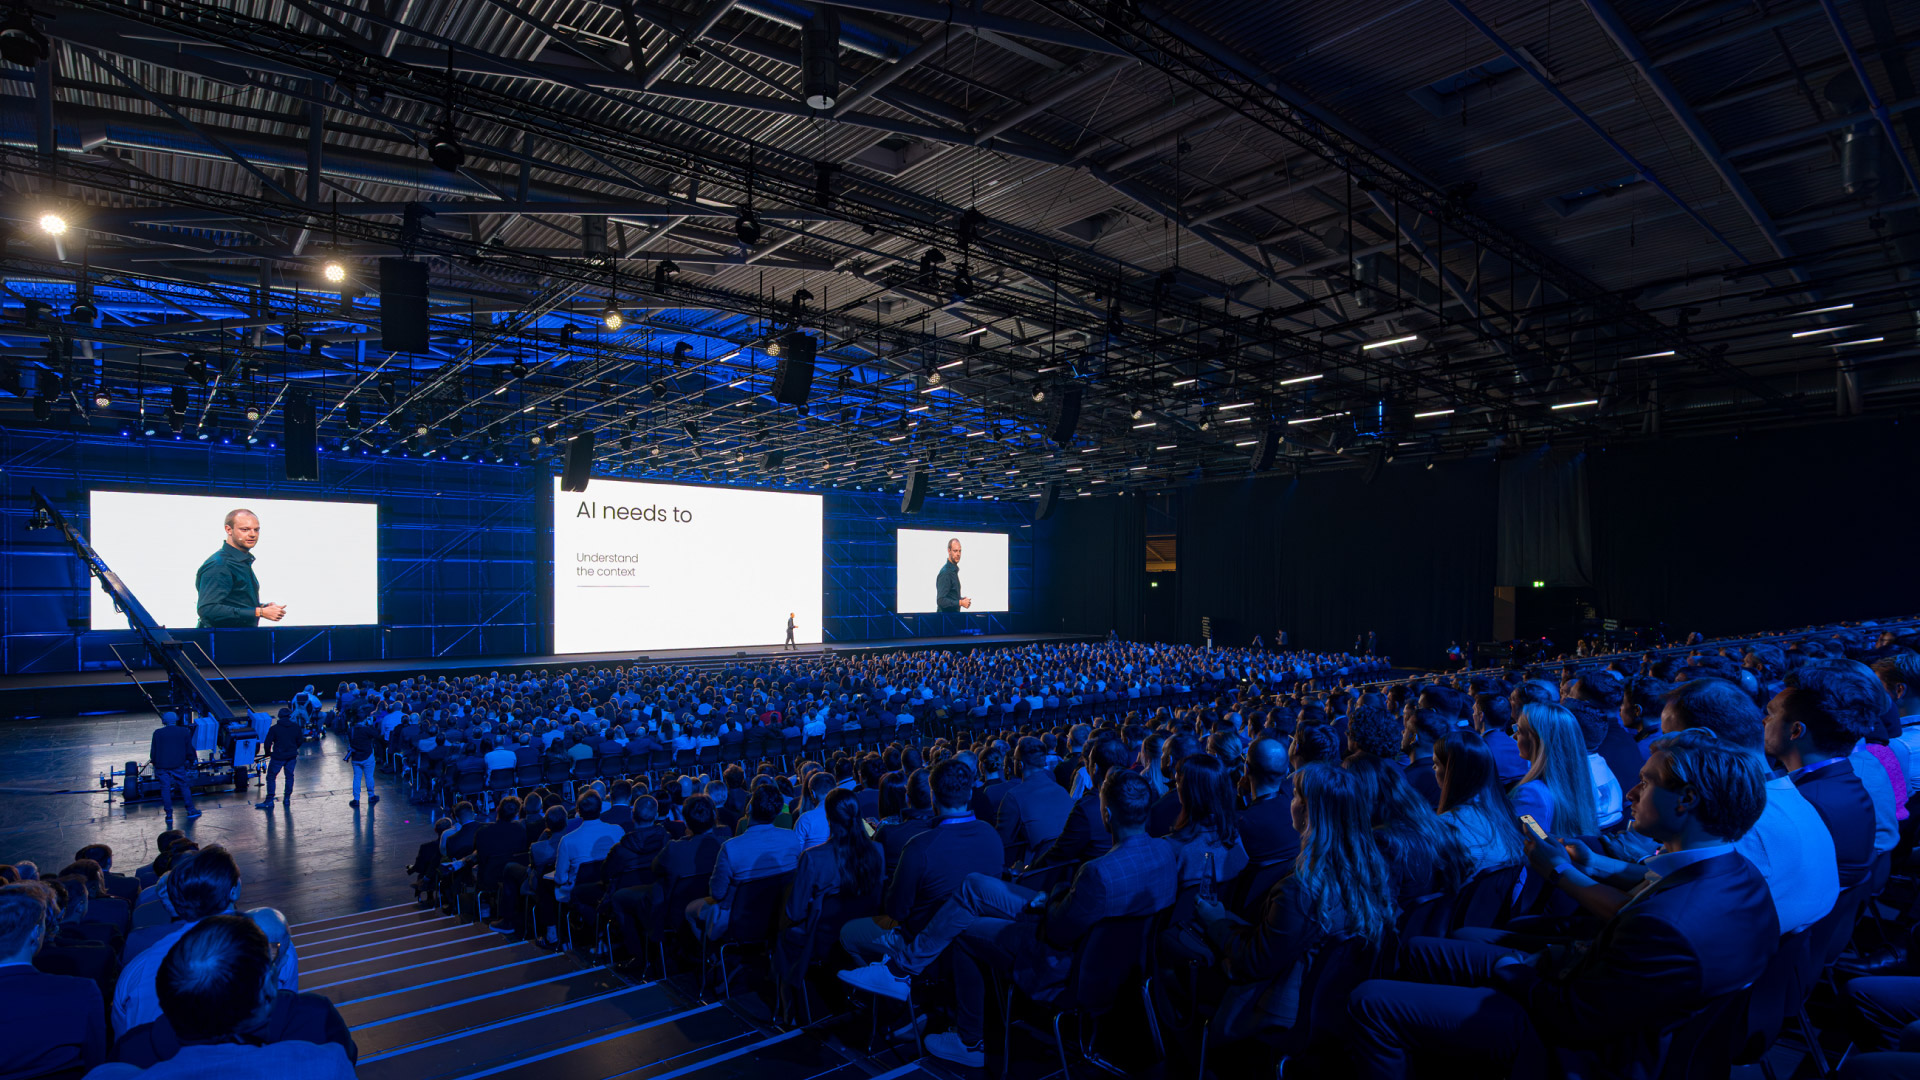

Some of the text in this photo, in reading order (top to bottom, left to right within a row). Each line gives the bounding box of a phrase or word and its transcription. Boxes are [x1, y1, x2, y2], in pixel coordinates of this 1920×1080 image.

[576, 501, 693, 523] AI needs to
[576, 552, 639, 563] Understand
[576, 566, 636, 577] the context
